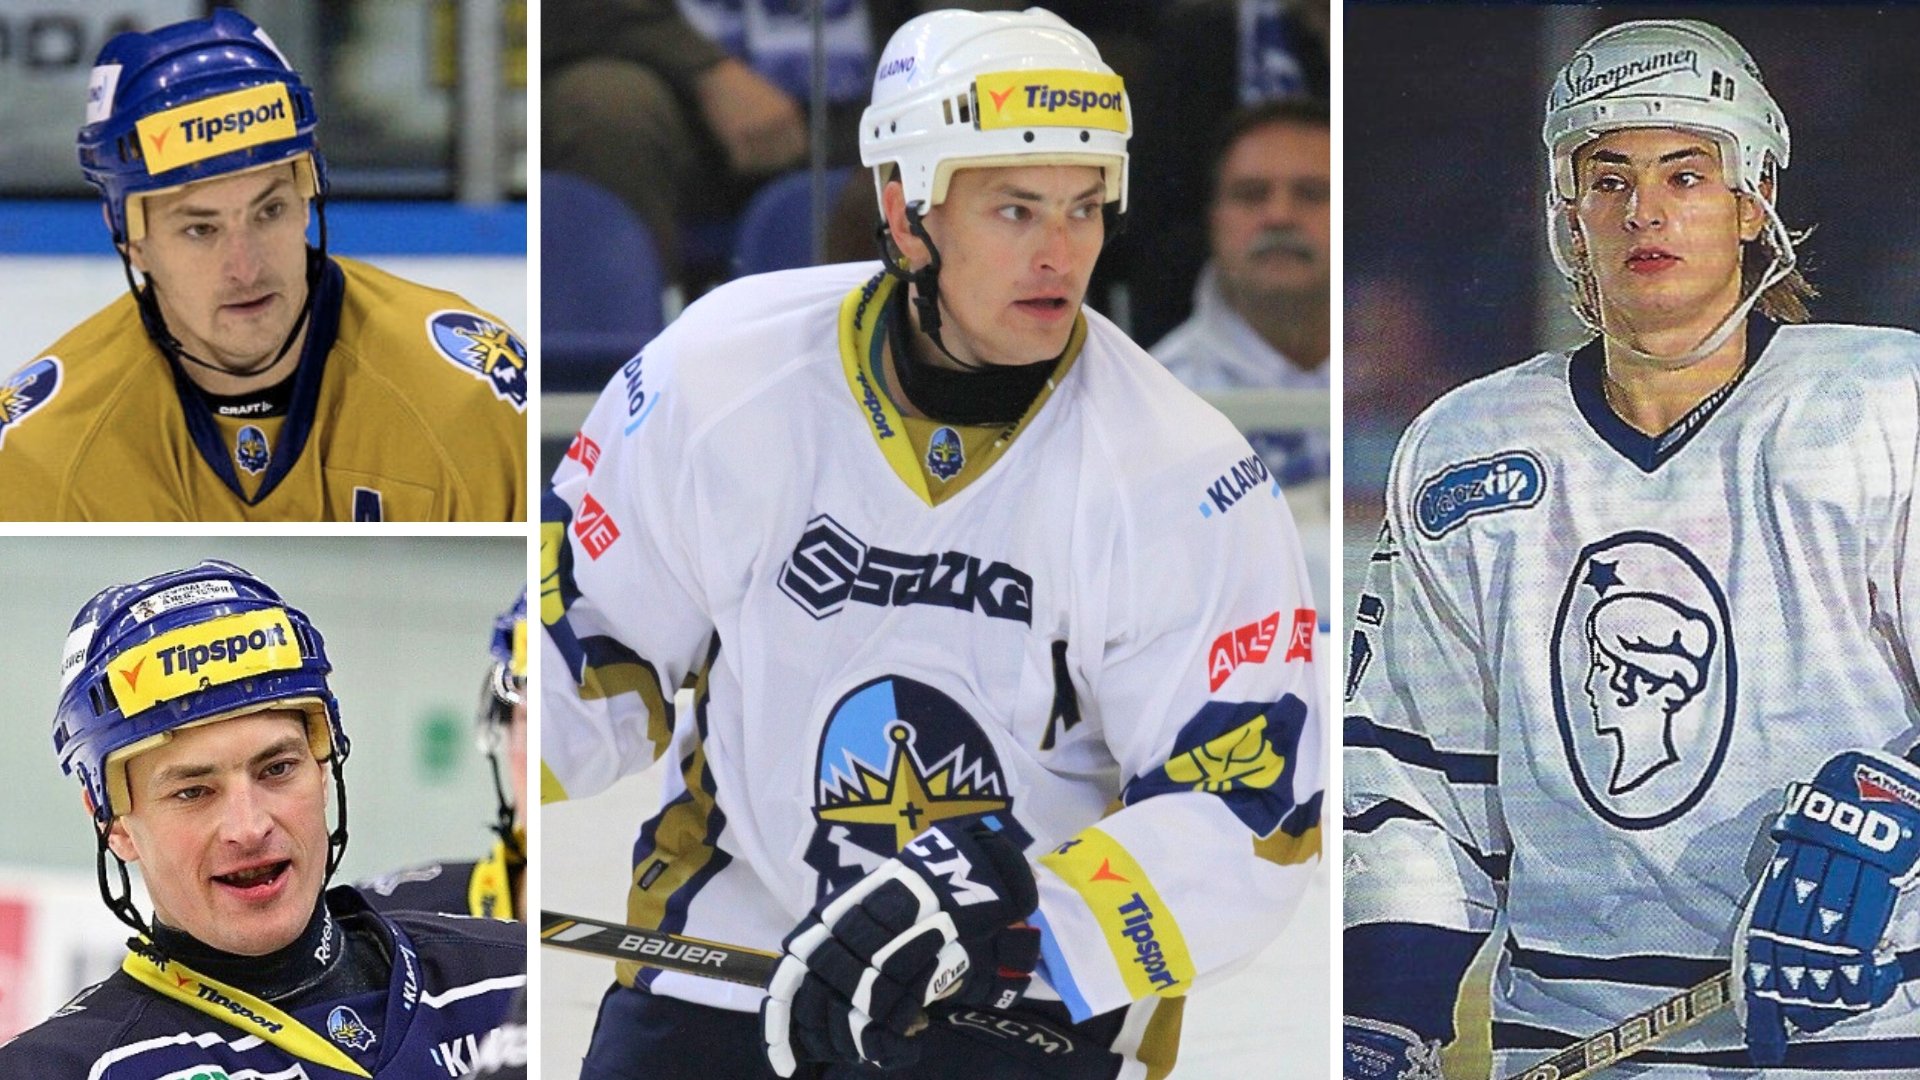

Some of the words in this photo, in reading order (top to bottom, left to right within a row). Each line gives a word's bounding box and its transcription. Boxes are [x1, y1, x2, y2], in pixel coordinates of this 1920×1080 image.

[1024, 84, 1122, 112] Tipsport
[1565, 51, 1701, 105] Staropramen
[180, 97, 285, 143] Tipsport
[218, 403, 261, 415] CRAFT
[156, 623, 288, 676] Tipsport
